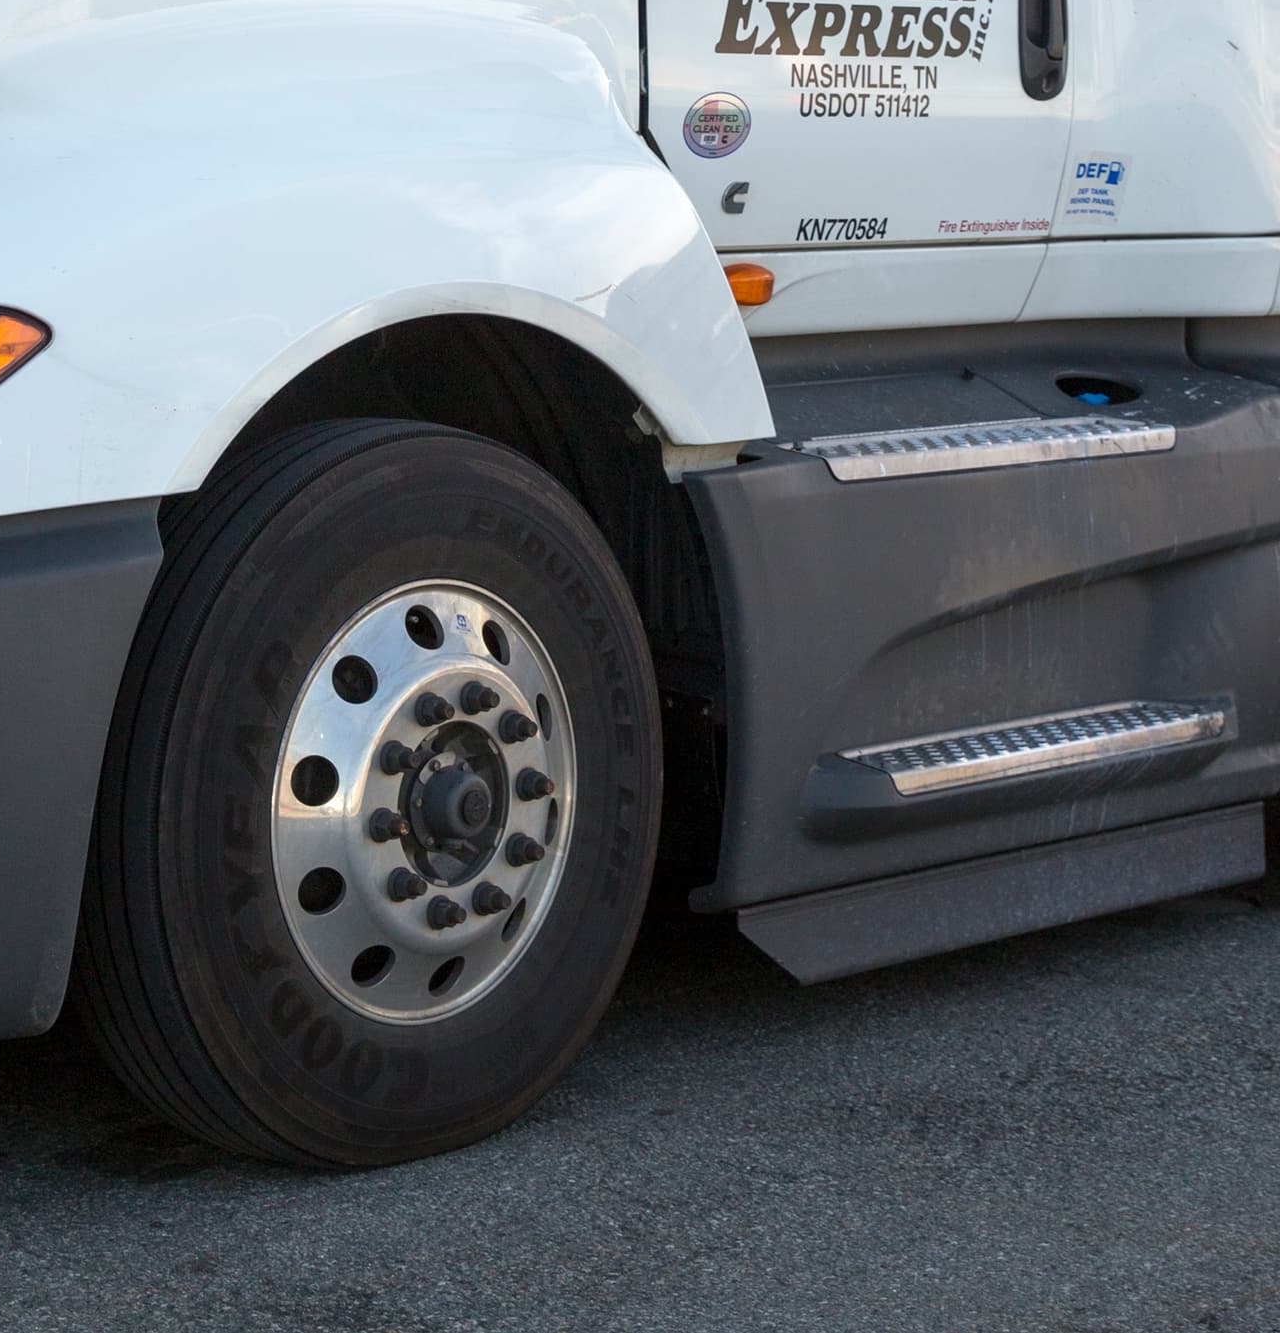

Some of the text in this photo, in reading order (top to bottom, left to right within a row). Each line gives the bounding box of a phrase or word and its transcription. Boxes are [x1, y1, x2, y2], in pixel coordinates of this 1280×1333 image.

[791, 63, 937, 93] NASHVILLE, TN
[800, 93, 930, 117] USDOT 511412
[698, 114, 739, 123] CERTIFIED
[693, 125, 742, 134] CLEAN IDLE
[1076, 163, 1109, 179] DEF
[796, 217, 888, 241] KN770584
[938, 218, 1050, 235] Fire Extinguisher Inside
